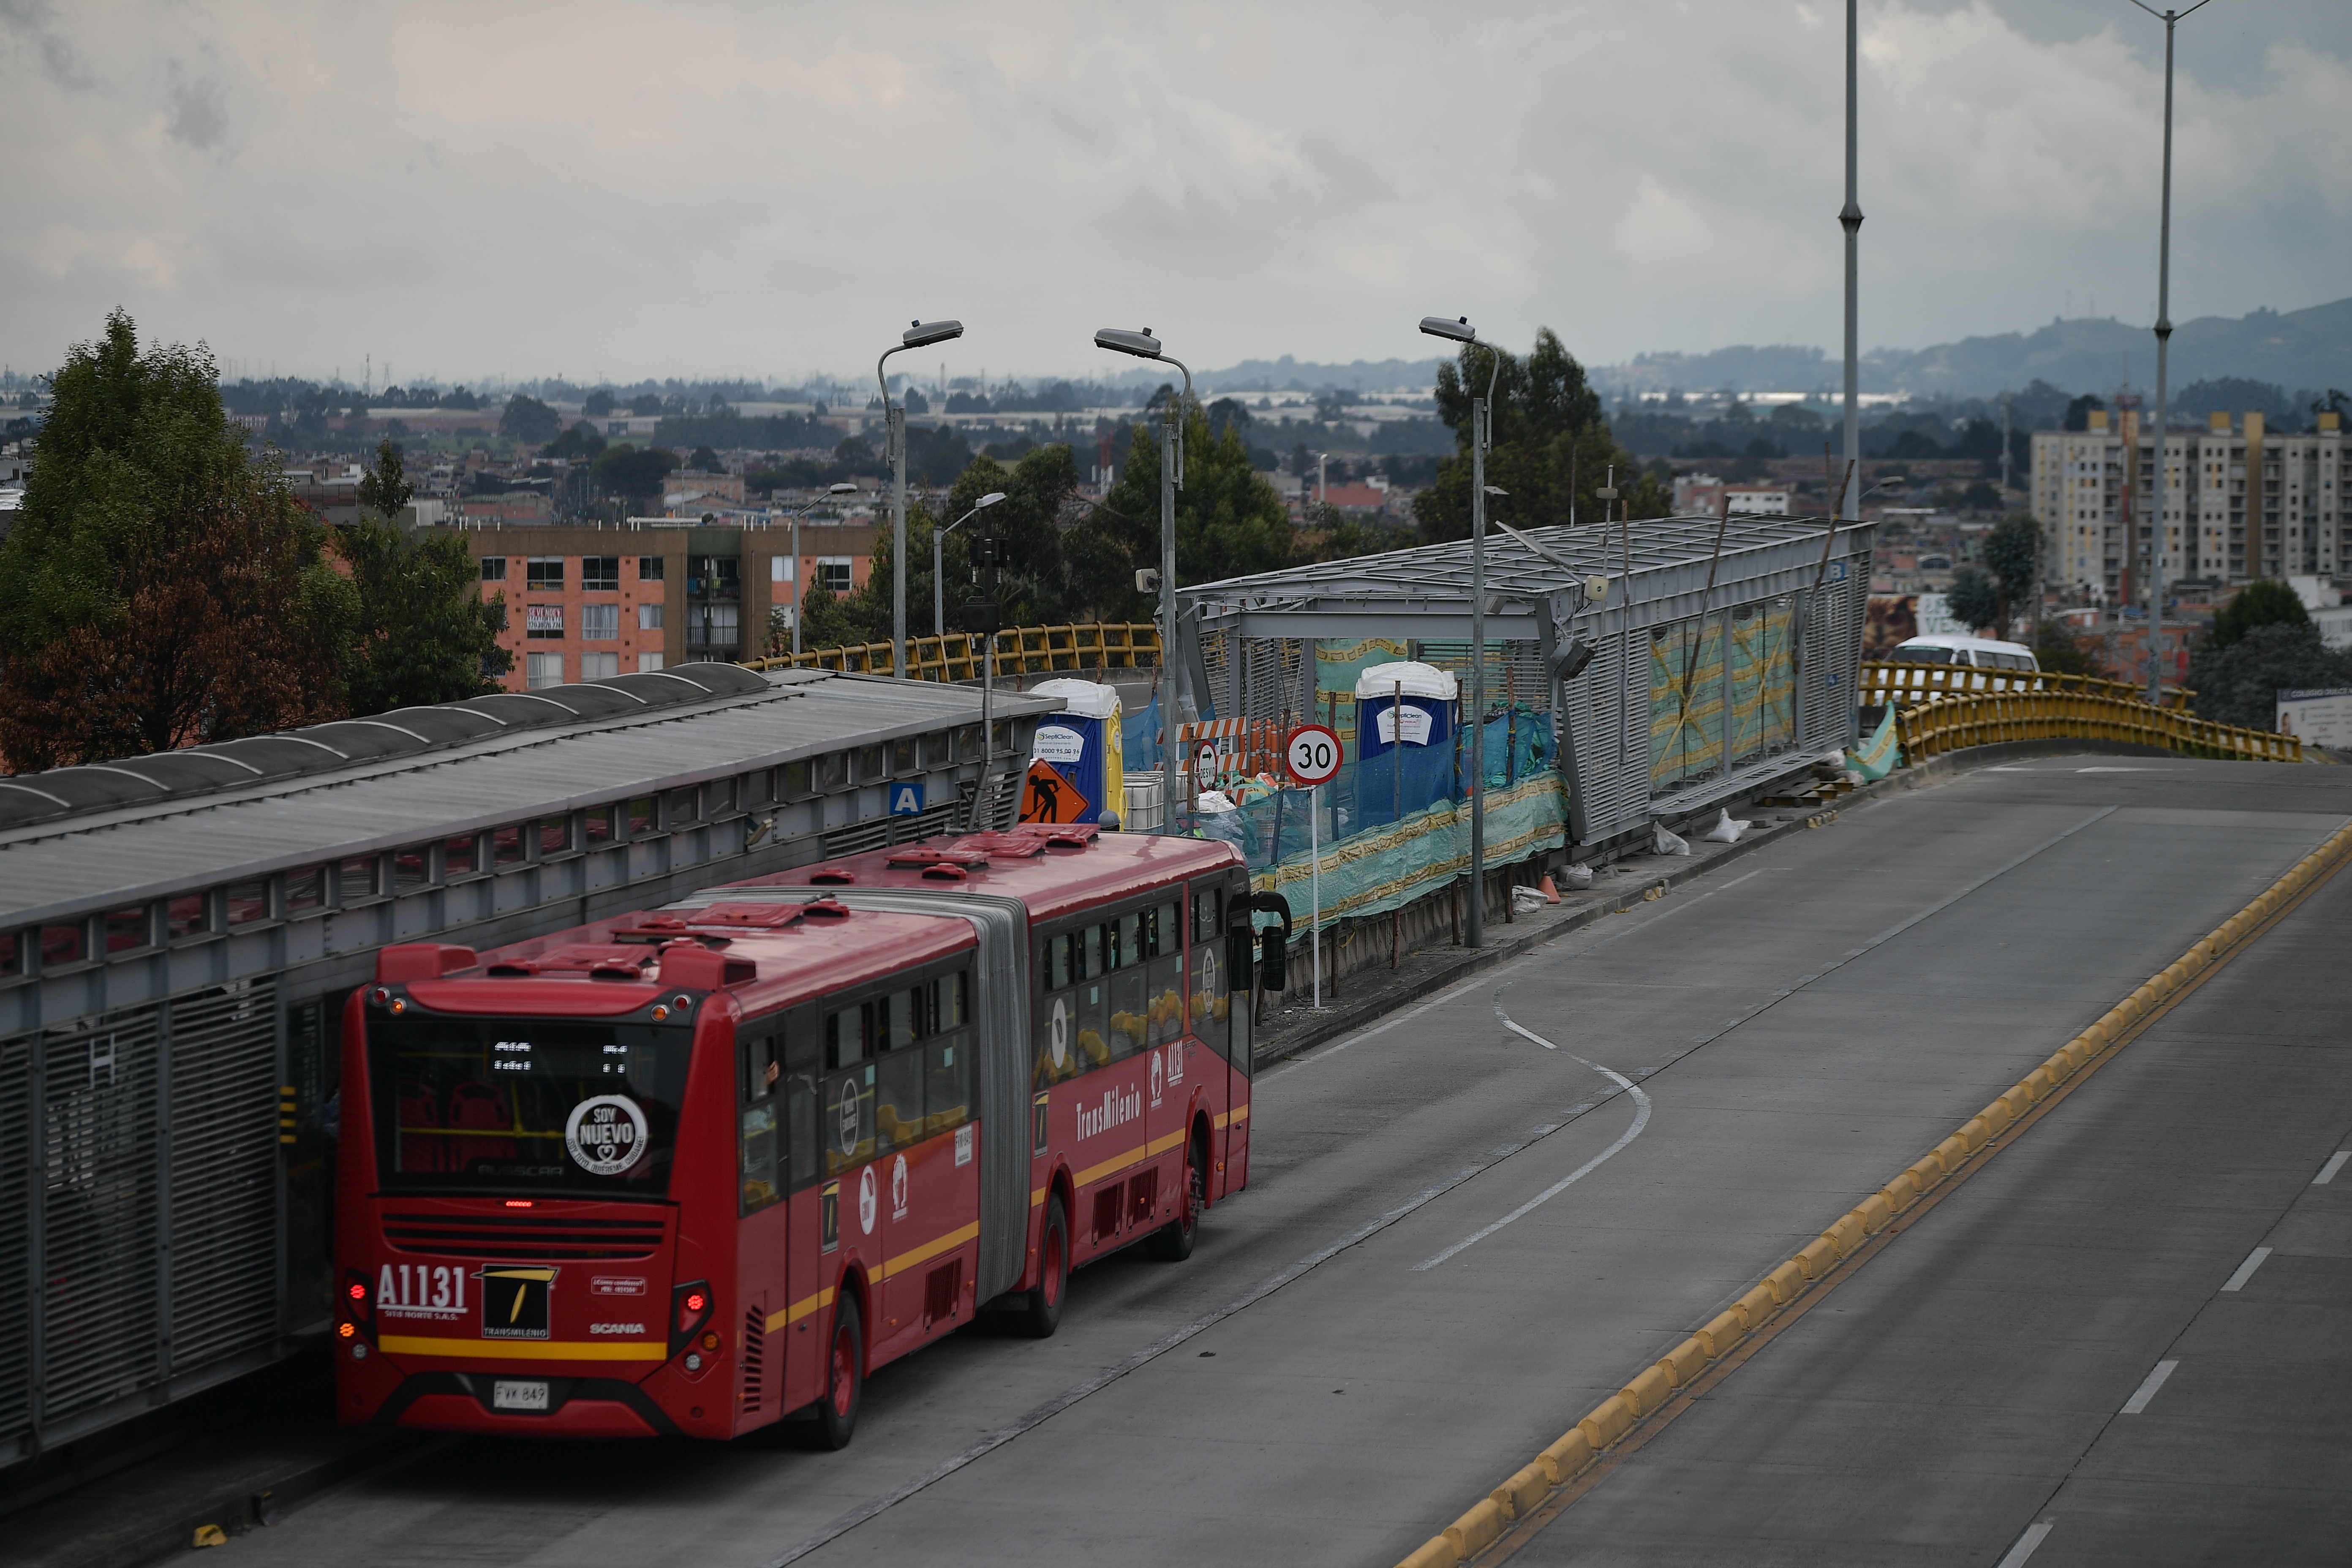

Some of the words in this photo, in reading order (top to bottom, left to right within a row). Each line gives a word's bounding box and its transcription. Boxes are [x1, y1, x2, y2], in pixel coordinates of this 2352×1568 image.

[1831, 564, 1842, 578] B
[1829, 675, 1836, 685] 4
[1298, 743, 1331, 769] 30
[1200, 766, 1215, 779] DESVIO
[895, 788, 918, 812] A
[1168, 1040, 1183, 1078] A1131
[593, 1107, 617, 1123] SOY
[1076, 1082, 1140, 1142] TransMilenio
[580, 1123, 634, 1145] NUEVO
[377, 1263, 464, 1309] A1131
[484, 1327, 546, 1337] TRANSMILENIO
[590, 1323, 645, 1334] SCANIA
[523, 1388, 544, 1401] 849
